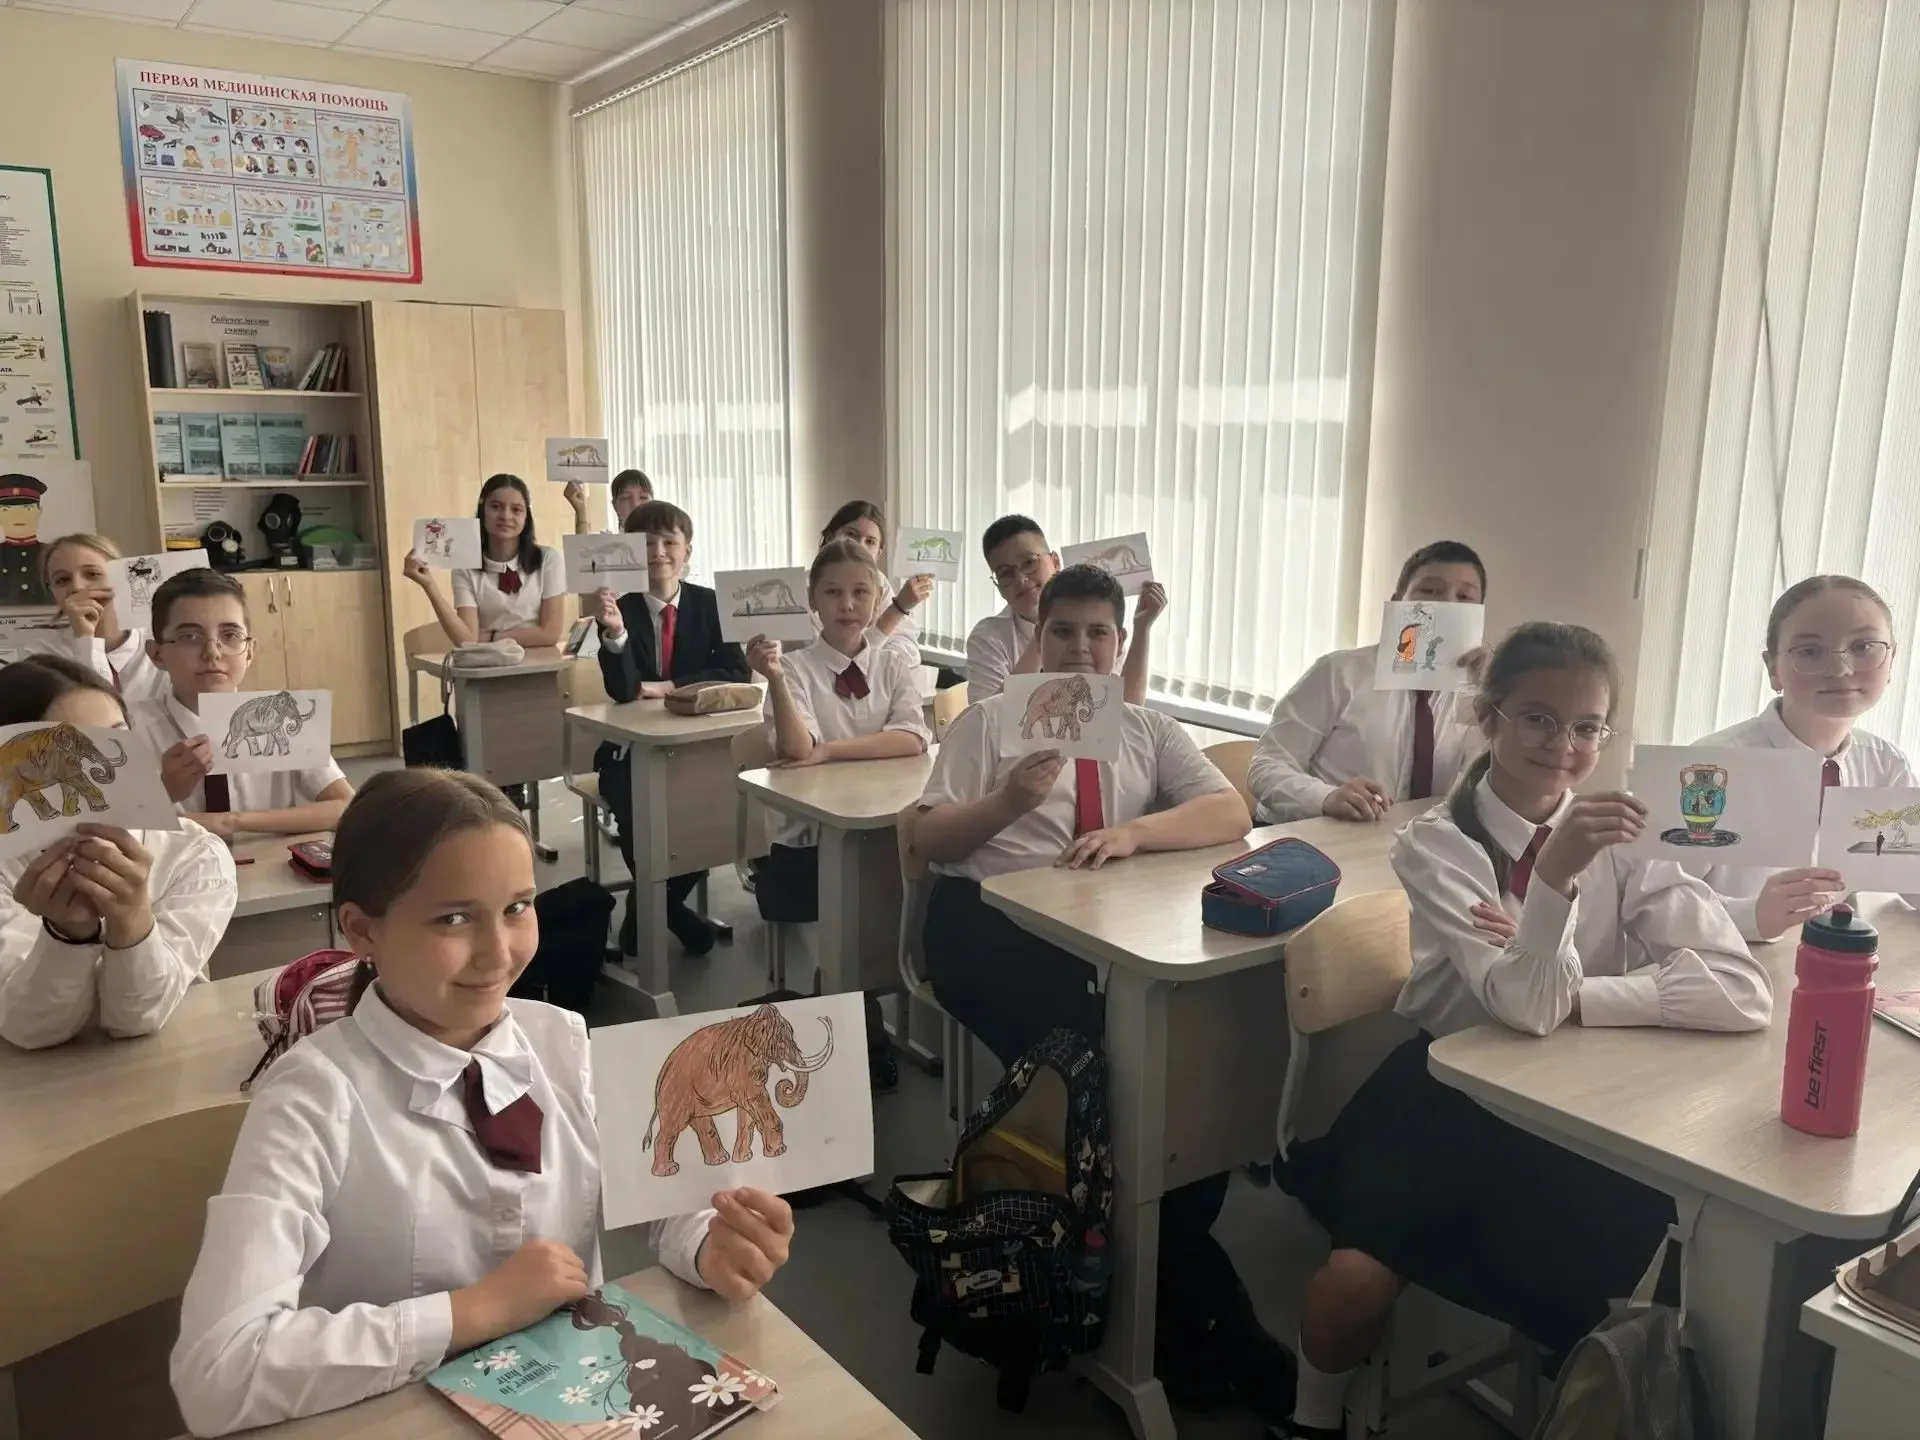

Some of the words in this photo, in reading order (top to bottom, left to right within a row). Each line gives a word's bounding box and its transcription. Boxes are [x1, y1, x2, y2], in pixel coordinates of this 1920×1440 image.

[140, 71, 199, 88] ПЕРВАЯ
[203, 78, 317, 101] МЕДИЦИНСКАЯ
[321, 93, 389, 112] ПОМОЩЬ
[1804, 1078, 1821, 1109] be
[513, 1362, 560, 1388] Summer
[520, 1359, 541, 1373] her
[496, 1369, 522, 1385] hair
[499, 1386, 515, 1396] in
